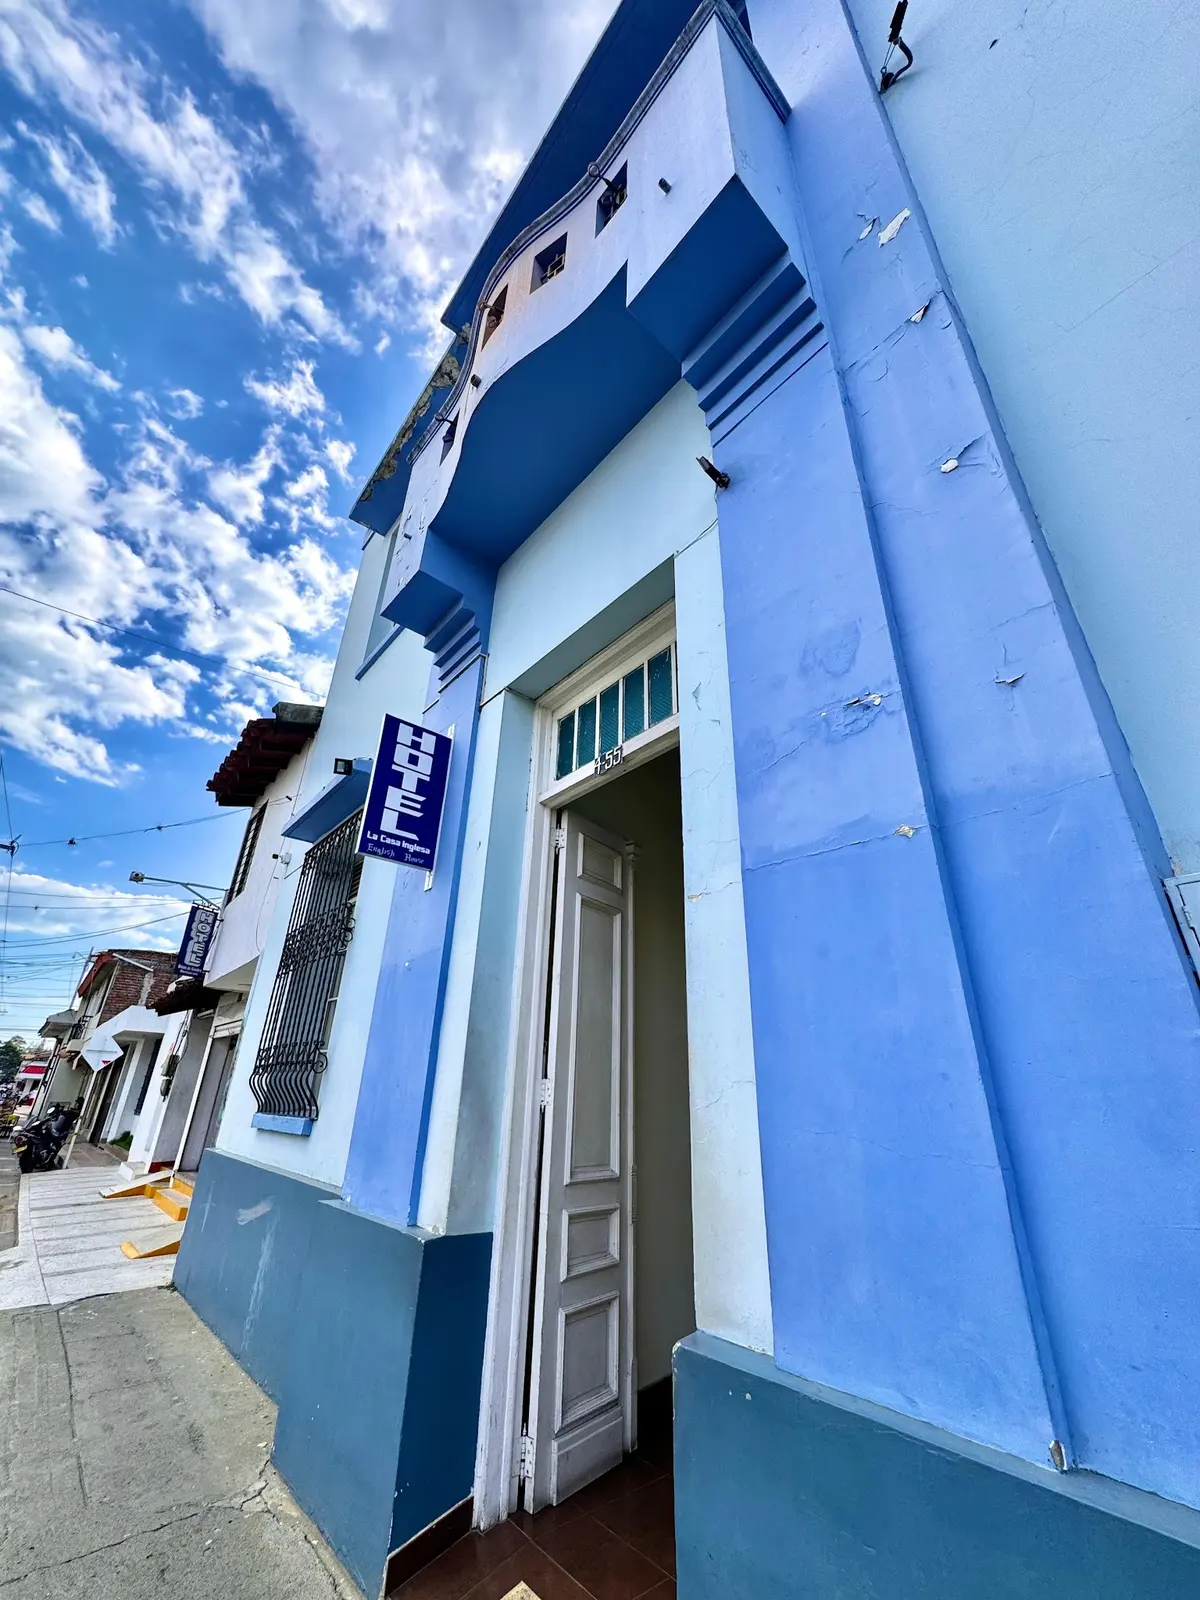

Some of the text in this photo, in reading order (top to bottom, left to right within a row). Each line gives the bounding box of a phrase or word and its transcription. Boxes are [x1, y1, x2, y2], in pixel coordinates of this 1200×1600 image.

[380, 723, 436, 841] HOTEL
[366, 830, 431, 855] La Casa Inglesa
[366, 843, 425, 864] English House
[186, 911, 215, 967] HOTEL
